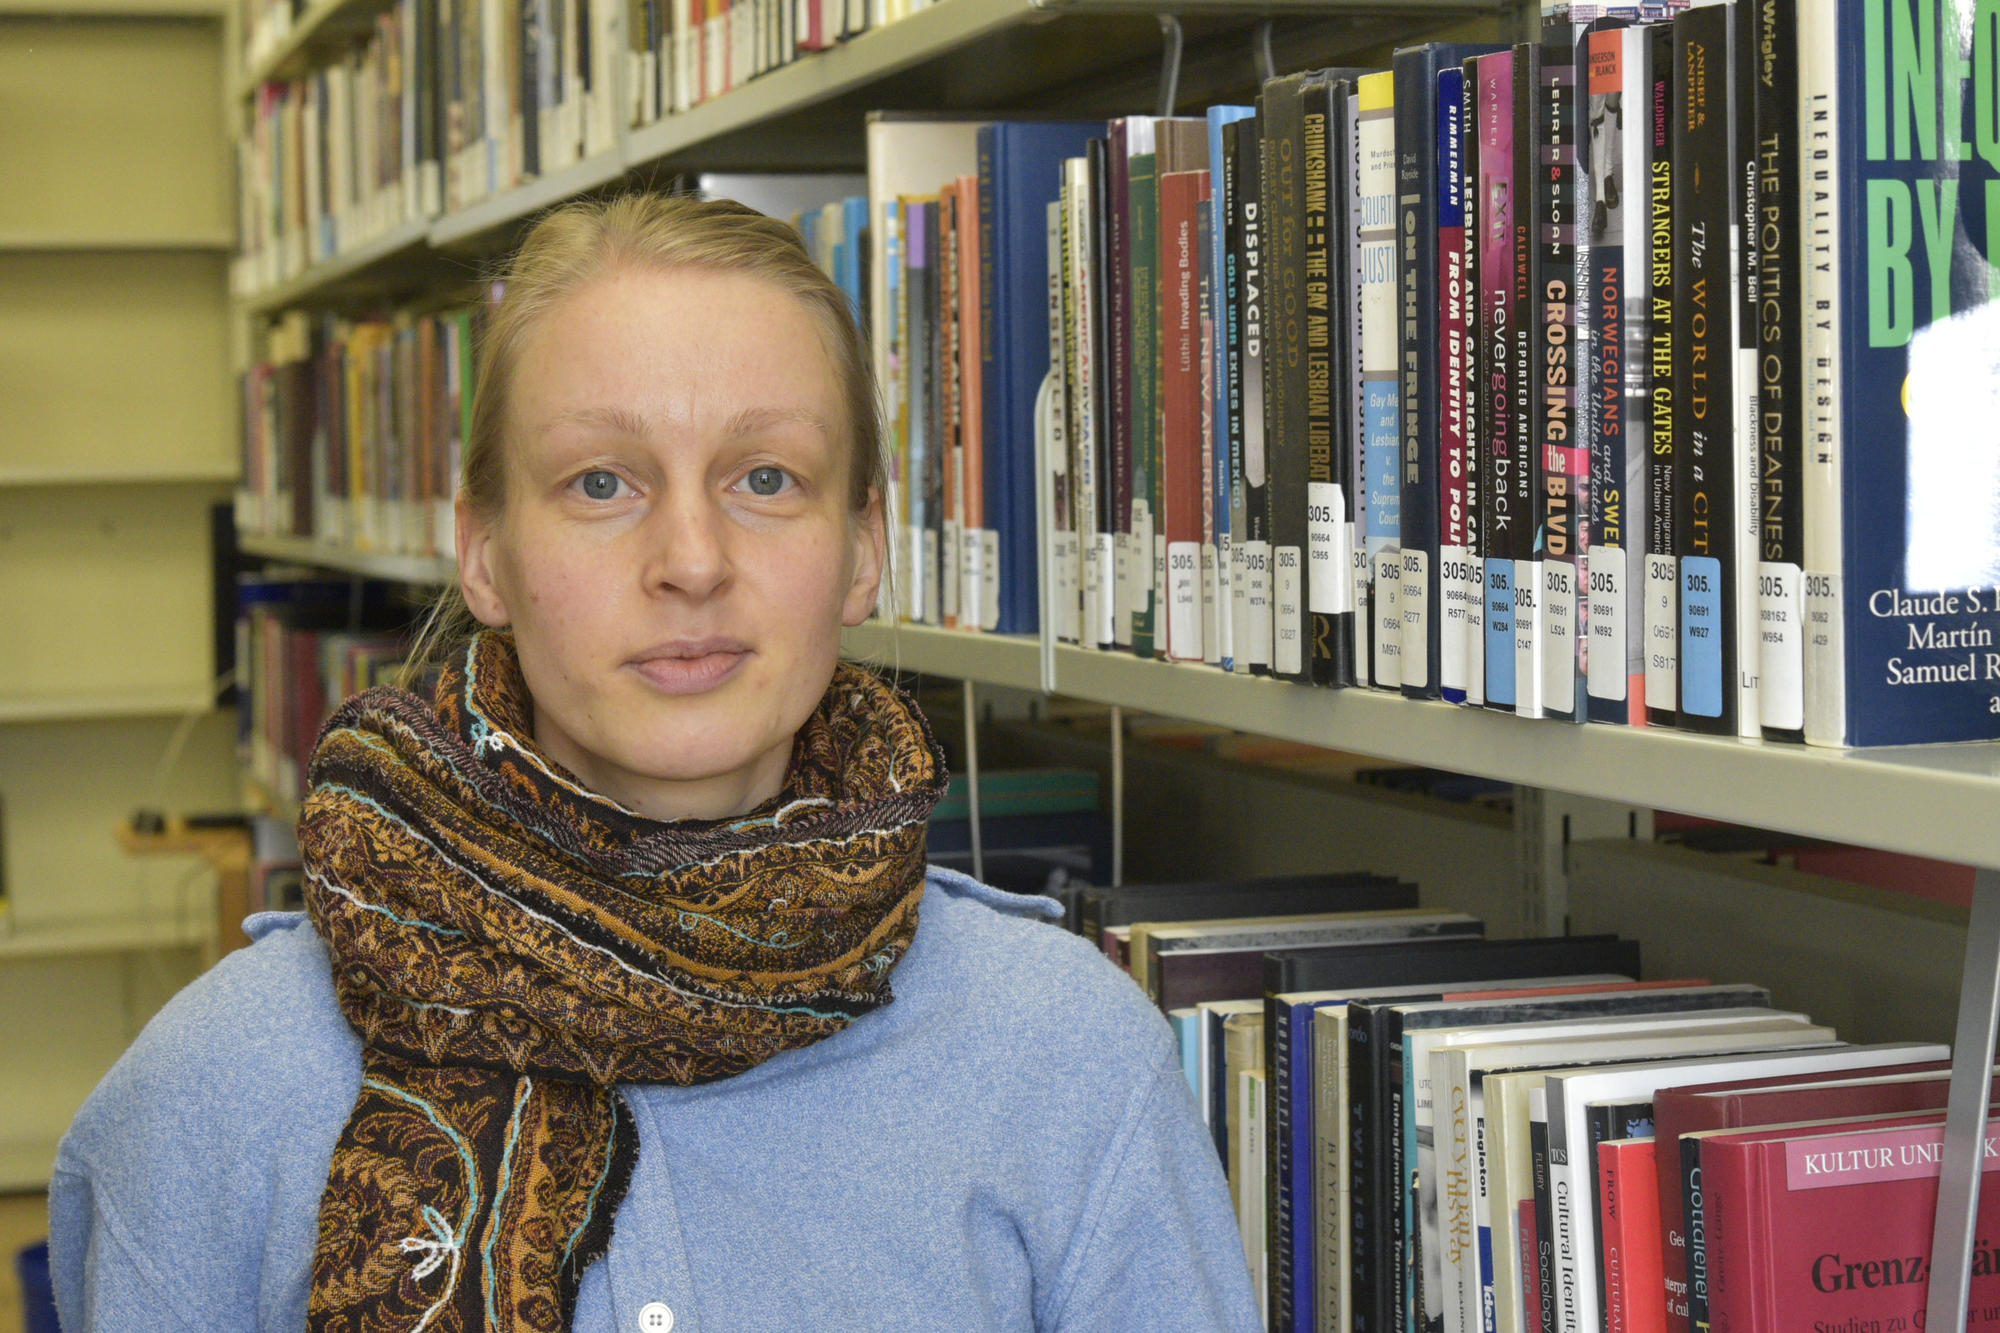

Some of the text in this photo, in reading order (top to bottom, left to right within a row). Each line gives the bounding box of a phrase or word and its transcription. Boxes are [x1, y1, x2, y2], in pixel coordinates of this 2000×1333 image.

[1761, 0, 1777, 87] Wrigley
[1463, 79, 1472, 134] SMITH
[1687, 41, 1697, 132] LANPHIER
[1696, 44, 1707, 128] ANISEF &
[1489, 79, 1498, 146] WARNER
[1655, 80, 1665, 147] WALDINGER
[1304, 112, 1327, 214] CRUIKSHANK
[1402, 152, 1417, 166] David
[1448, 104, 1460, 206] RIMMERMAN
[1551, 77, 1561, 255] LEHRER SLOAN
[1761, 132, 1780, 194] THE
[1225, 156, 1233, 226] SCHREIBER
[1491, 182, 1508, 243] EXIT
[1178, 220, 1189, 268] Bodies
[1280, 137, 1300, 369] OUT for GOOD
[1692, 221, 1707, 269] The
[1745, 160, 1758, 303] Christopher M. Bell
[1211, 235, 1219, 289] European
[1245, 203, 1261, 358] DISPLACED
[1306, 247, 1329, 279] THE
[1516, 225, 1527, 300] CALDWELL
[1762, 206, 1782, 343] POLITICS
[1813, 95, 1833, 465] INEQUALITY BY DESIGN
[1866, 179, 1960, 347] BY
[1179, 271, 1191, 330] Invading
[1306, 281, 1330, 311] GAY
[1651, 160, 1673, 456] STRANGERS AT THE GATES
[1199, 273, 1211, 401] THE NEW
[1307, 314, 1330, 348] AND
[1405, 210, 1420, 484] ON THE FRINGE
[1463, 175, 1477, 507] LESBIAN AND GAY RIGHTS IN
[1692, 277, 1708, 420] WORLD
[1050, 273, 1063, 441] UNSETTLED
[1114, 316, 1123, 416] IMMIGRANT
[1214, 353, 1222, 400] Families
[1227, 253, 1242, 509] COLD WAR EXILES IN MEXICO
[1449, 251, 1461, 478] FROM IDENTITY TO
[1602, 267, 1619, 484] NORWEGIANS and
[1763, 354, 1783, 400] OF
[1308, 352, 1331, 417] LESBIAN
[1370, 393, 1386, 409] Gay
[1380, 413, 1395, 427] and
[1518, 331, 1528, 499] DEPORTED AMERICANS
[1546, 280, 1567, 555] CROSSING the BLVD
[1590, 329, 1603, 525] in the United States
[1693, 431, 1708, 457] in
[1749, 395, 1760, 537] Blackness and Disability
[1382, 473, 1395, 487] the
[1653, 465, 1662, 512] in Urban
[1663, 465, 1672, 485] New
[1693, 465, 1704, 482] a
[1308, 505, 1335, 523] 305.
[1171, 554, 1197, 570] 305.
[1279, 552, 1297, 568] 305.
[1402, 555, 1423, 573] 305.
[1490, 573, 1510, 591] 305.
[1546, 572, 1571, 594] 305.
[1590, 572, 1618, 593] 305.
[1687, 574, 1712, 593] 305.
[1446, 590, 1467, 602] 90664
[1491, 601, 1509, 613] 90664
[1548, 603, 1568, 617] 90691
[1593, 603, 1614, 616] 90691
[1661, 595, 1668, 608] 9
[1688, 605, 1709, 617] 90691
[1759, 576, 1789, 598] 305.
[1806, 578, 1835, 598] 305.
[1868, 584, 1988, 618] Claude S.
[1447, 608, 1467, 620] R577
[1492, 620, 1509, 633] W284
[1550, 623, 1566, 637] L524
[1595, 624, 1613, 637] N892
[1689, 626, 1709, 638] W927
[1762, 630, 1784, 643] W954
[1906, 621, 1993, 650] Martín
[1517, 638, 1532, 650] C147
[1886, 652, 1977, 685] Samuel
[1391, 1092, 1402, 1234] Entanglements, or
[1476, 1117, 1488, 1198] Eagleton
[1535, 1152, 1545, 1191] FLEURY
[1551, 1148, 1567, 1164] TCS
[1804, 1146, 1895, 1175] KULTUR
[1327, 1141, 1338, 1267] BEYOND
[1352, 1103, 1364, 1282] TWILIGHT
[1606, 1169, 1617, 1221] FROW
[1556, 1180, 1573, 1261] Cultural
[1520, 1227, 1532, 1295] FISCHER
[1482, 1285, 1495, 1333] Idea
[1539, 1241, 1553, 1333] Sociology
[1610, 1246, 1624, 1333] CULTURAL
[1814, 1306, 1881, 1333] Studien
[1886, 1314, 1908, 1332] zu
